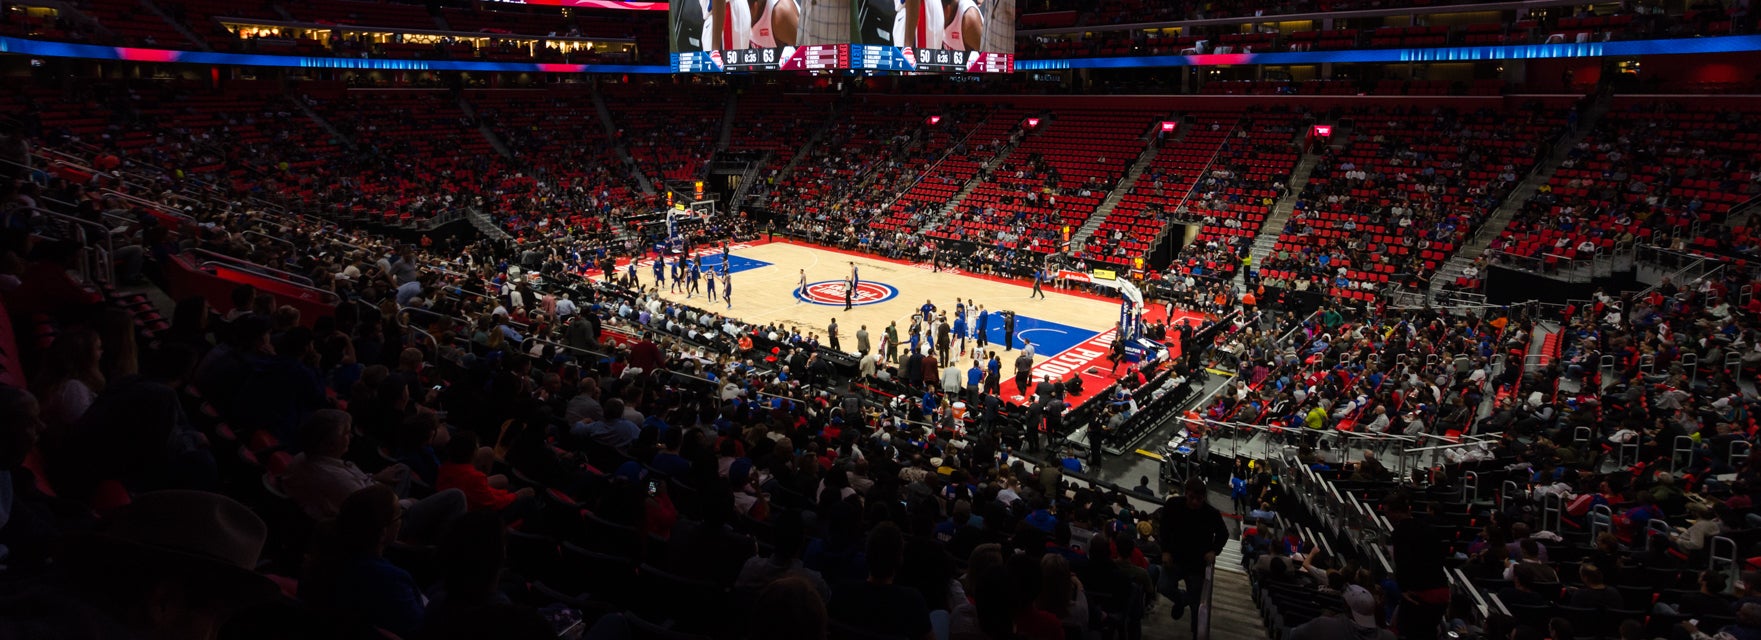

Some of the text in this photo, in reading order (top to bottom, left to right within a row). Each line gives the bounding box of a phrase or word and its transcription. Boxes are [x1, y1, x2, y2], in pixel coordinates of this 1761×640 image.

[727, 51, 737, 64] 50
[763, 49, 774, 62] 63
[920, 49, 930, 63] 50
[953, 51, 963, 64] 63
[1032, 347, 1104, 382] PISTON
